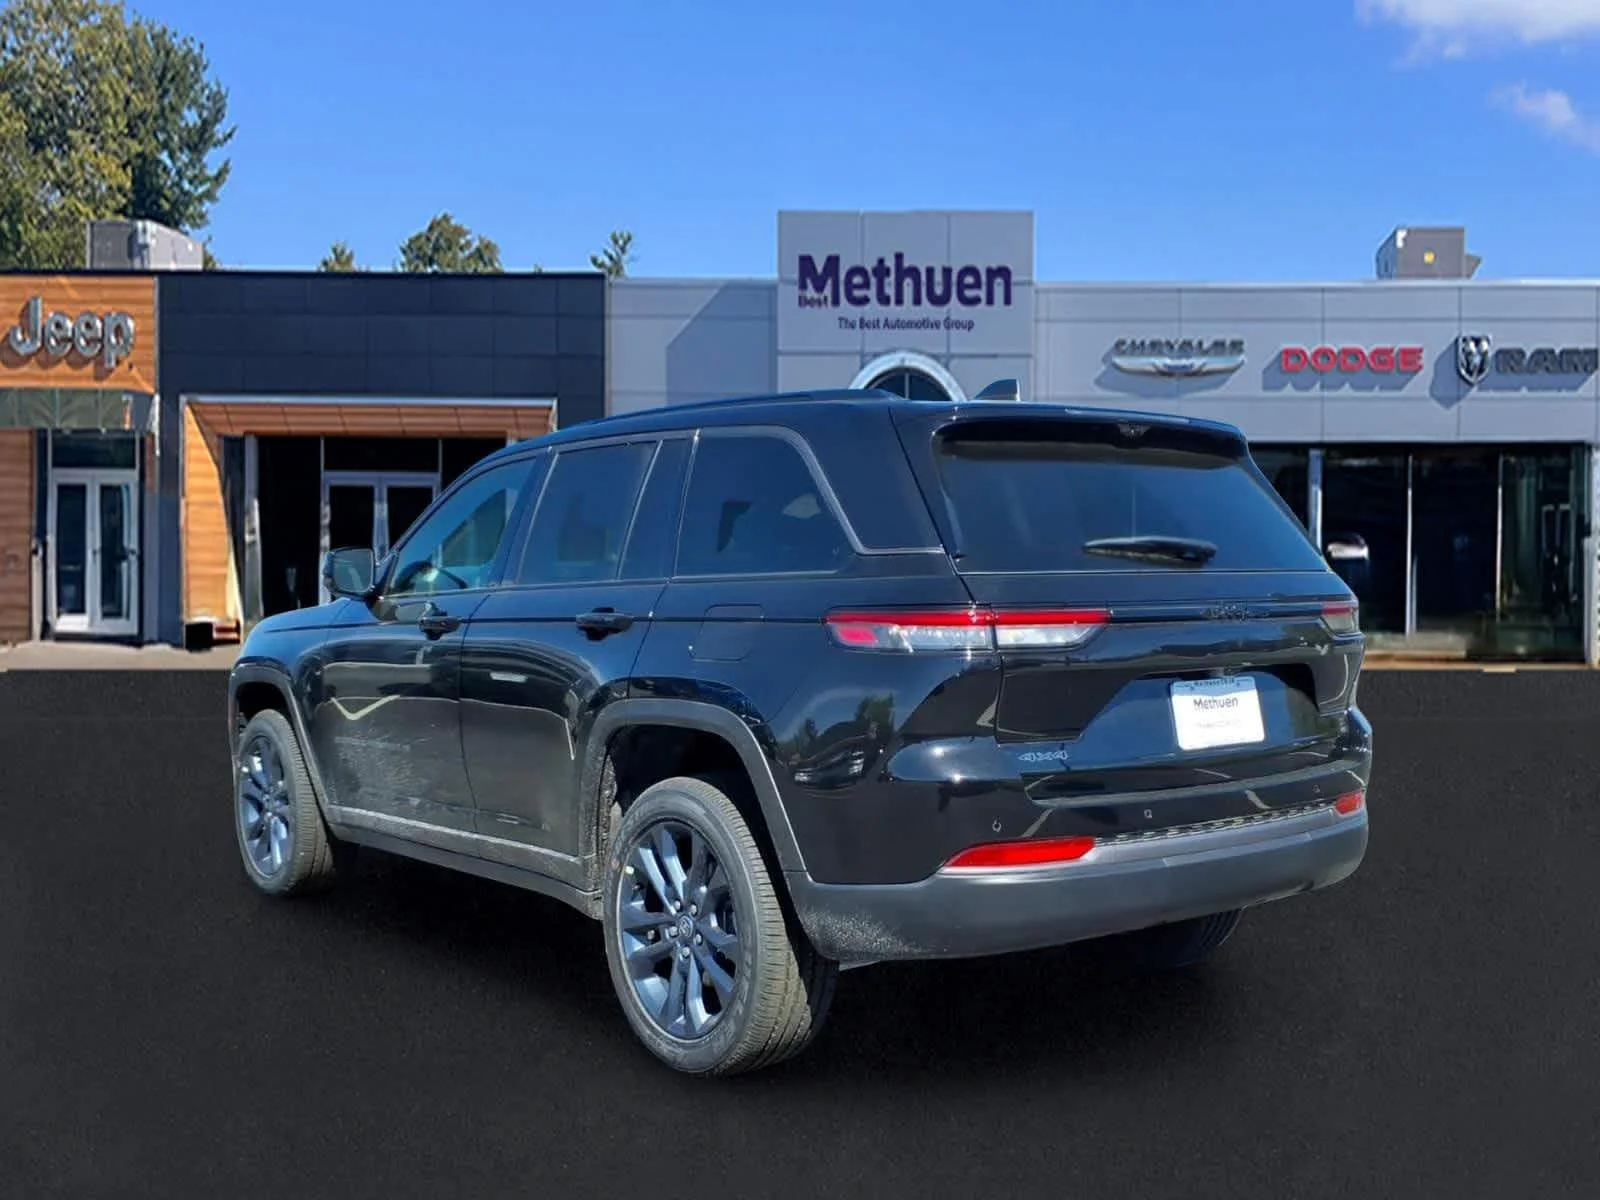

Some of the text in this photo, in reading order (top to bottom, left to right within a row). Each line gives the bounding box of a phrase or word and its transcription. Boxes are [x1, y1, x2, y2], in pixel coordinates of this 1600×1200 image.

[798, 252, 1012, 307] Methuen
[9, 296, 135, 369] Jeep
[838, 316, 975, 332] The Best Automotive Group
[1281, 347, 1424, 373] DODGE
[1495, 347, 1598, 374] RAM
[1193, 697, 1239, 710] Methuen
